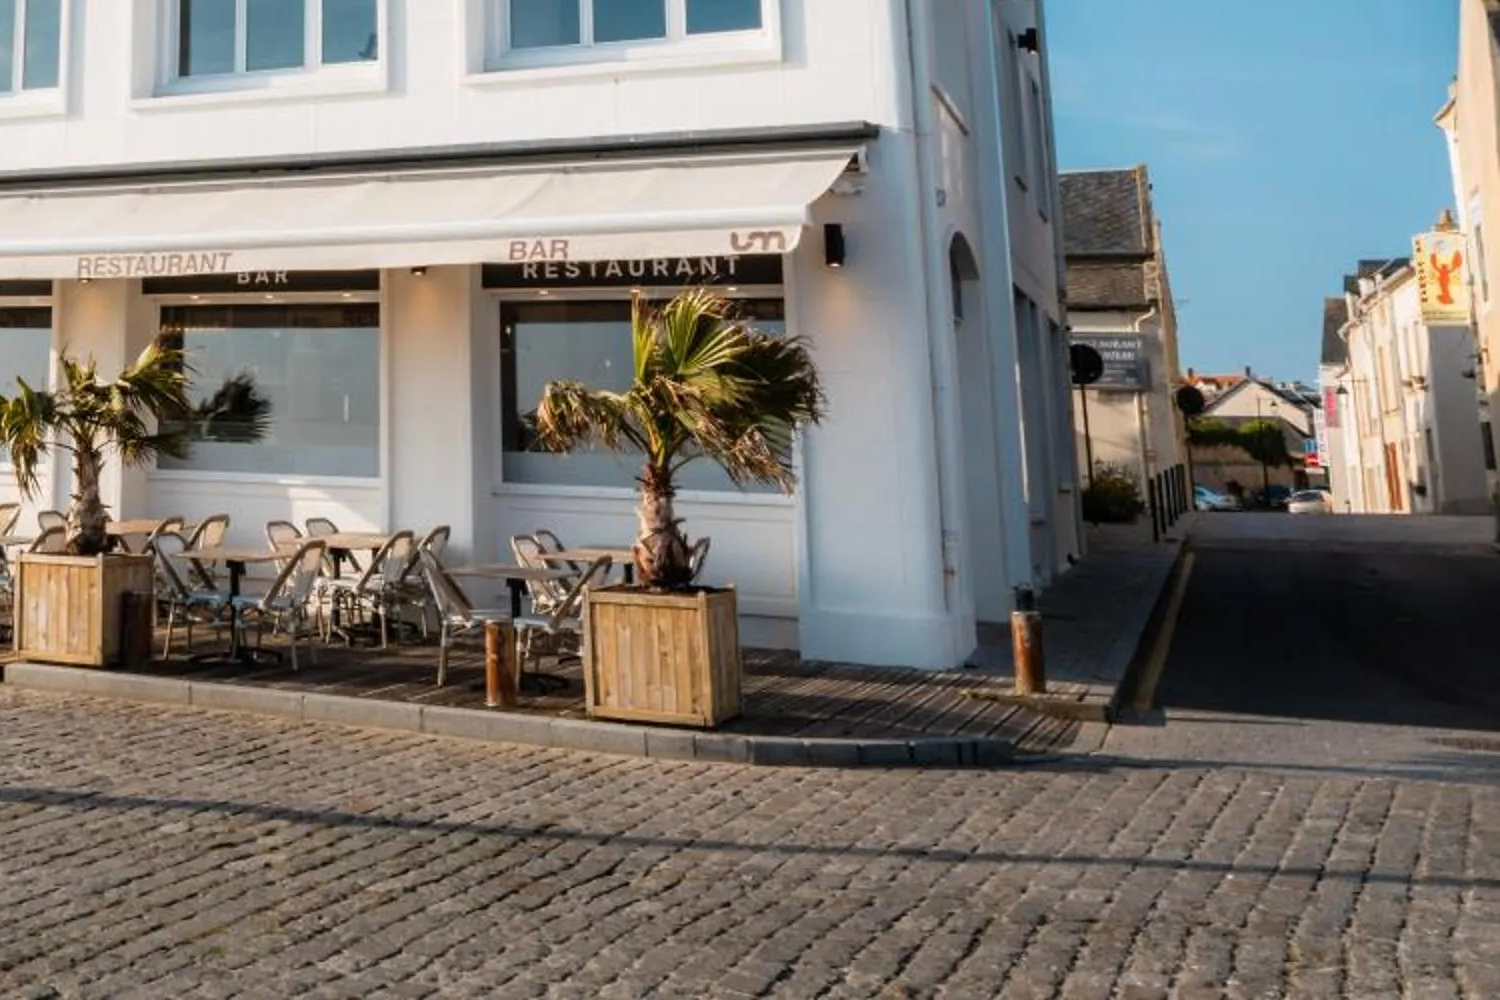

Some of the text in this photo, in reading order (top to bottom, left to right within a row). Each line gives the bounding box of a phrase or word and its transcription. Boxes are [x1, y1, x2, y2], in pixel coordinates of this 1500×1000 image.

[509, 239, 569, 261] BAR
[77, 252, 232, 276] RESTAURANT
[522, 255, 740, 279] RESTAURANT
[237, 270, 288, 285] BAR
